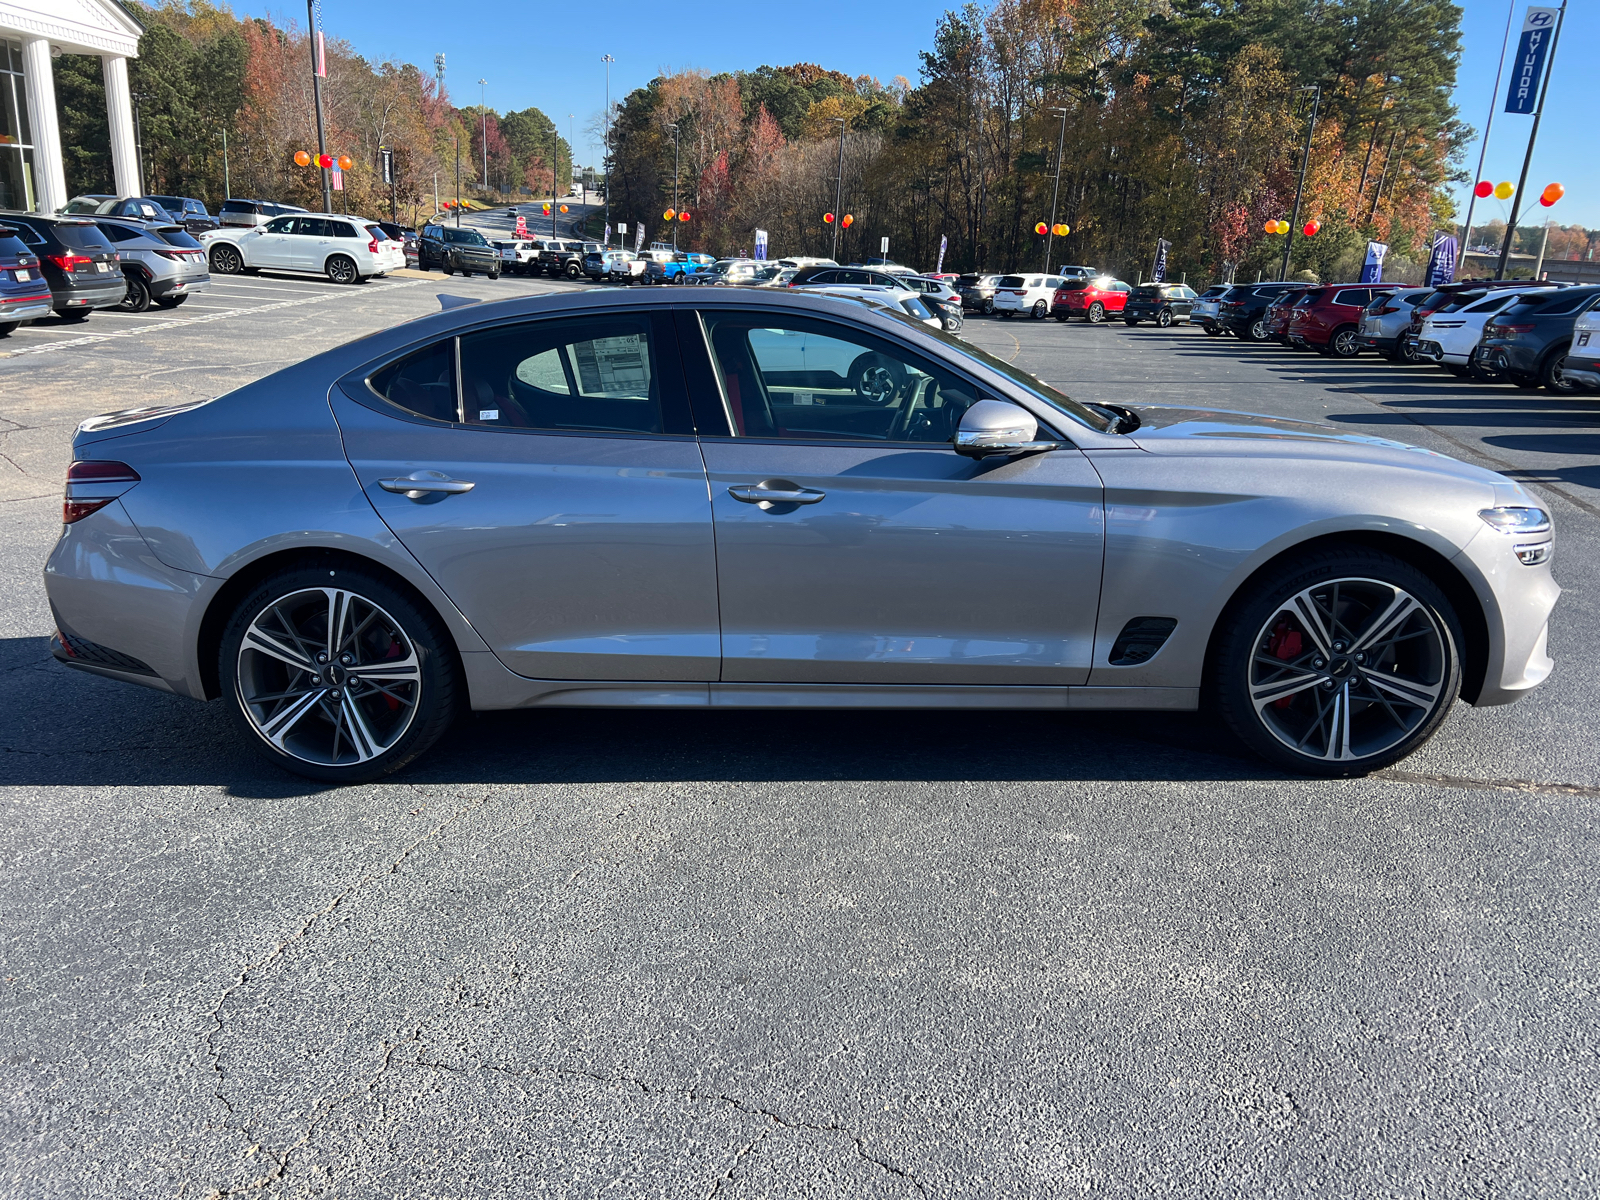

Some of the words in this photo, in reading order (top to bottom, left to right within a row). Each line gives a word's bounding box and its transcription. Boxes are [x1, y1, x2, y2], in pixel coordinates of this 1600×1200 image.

[1518, 31, 1542, 110] HYUNDAI
[1431, 251, 1447, 286] TIME
[237, 591, 267, 625] MICHELIN
